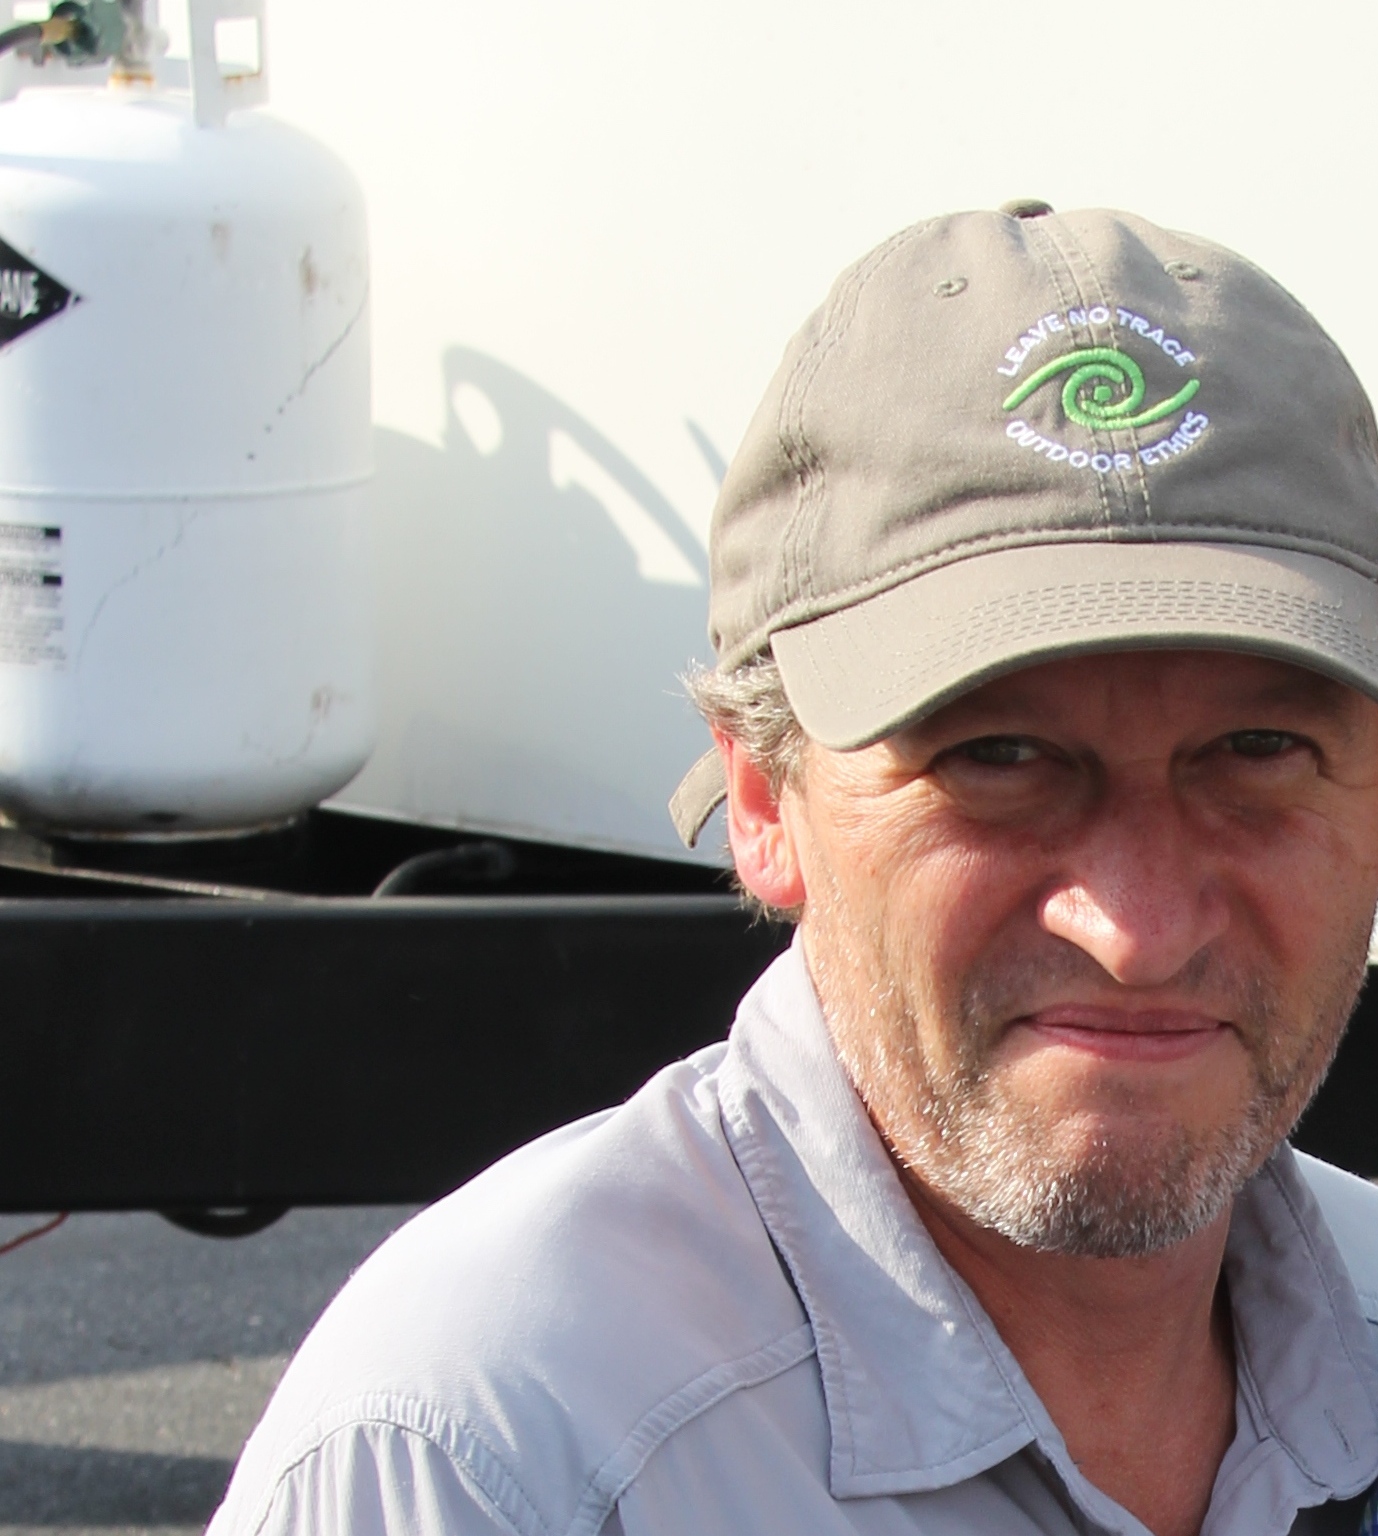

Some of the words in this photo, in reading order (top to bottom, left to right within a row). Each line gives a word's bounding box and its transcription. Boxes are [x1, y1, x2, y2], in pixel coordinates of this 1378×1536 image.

[997, 313, 1065, 377] LEAVE
[1069, 306, 1109, 326] NO
[1116, 307, 1196, 367] TRACE
[1006, 420, 1132, 473] OUTDOOR
[1138, 411, 1210, 465] ETHICS
